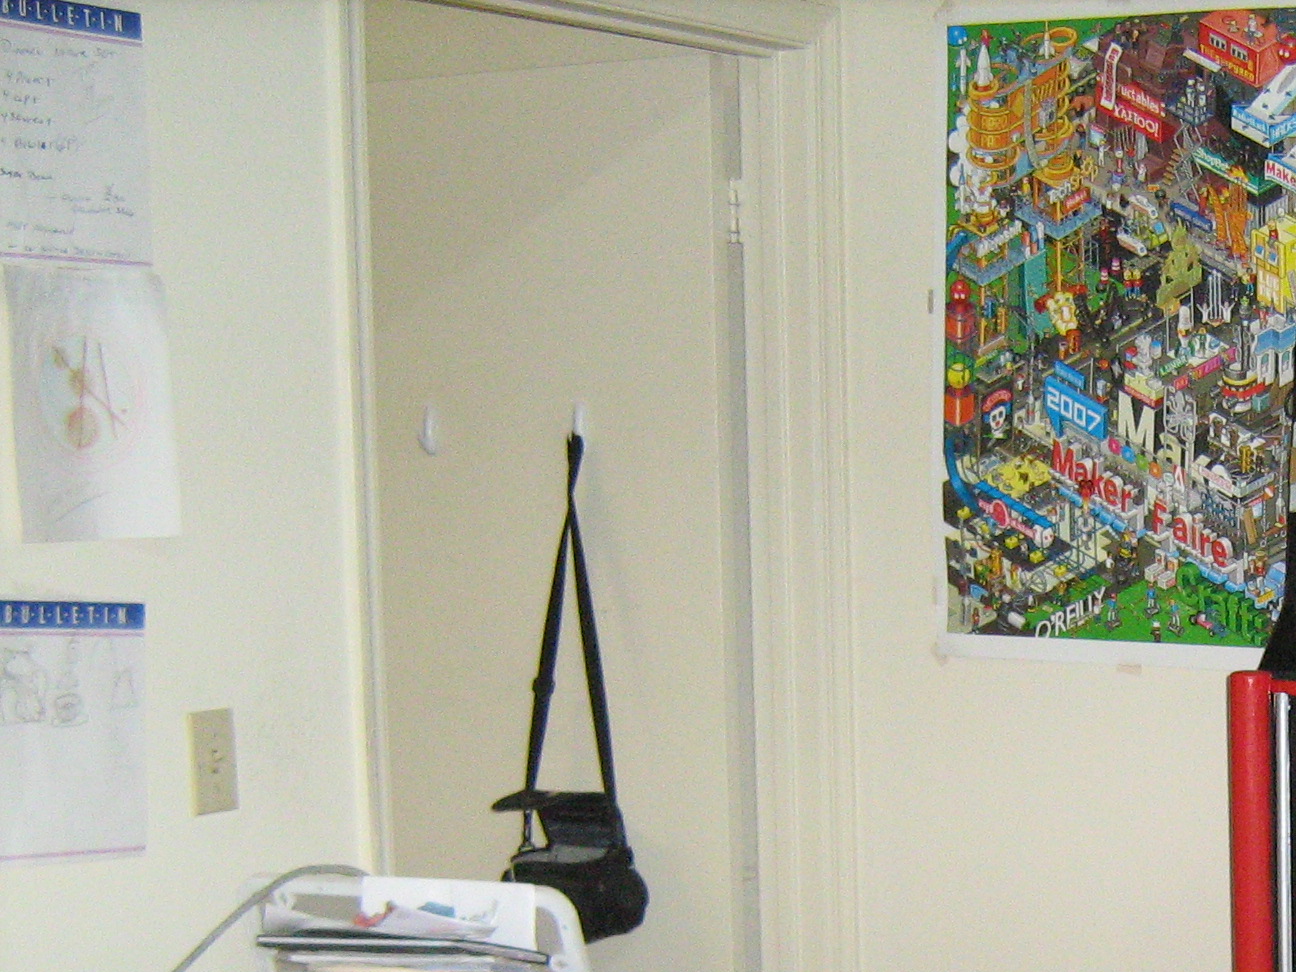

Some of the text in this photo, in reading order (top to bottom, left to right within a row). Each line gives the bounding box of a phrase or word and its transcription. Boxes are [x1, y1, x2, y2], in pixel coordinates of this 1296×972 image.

[1046, 386, 1101, 432] 2007
[1052, 438, 1133, 514] Maker
[1152, 500, 1232, 567] Faire
